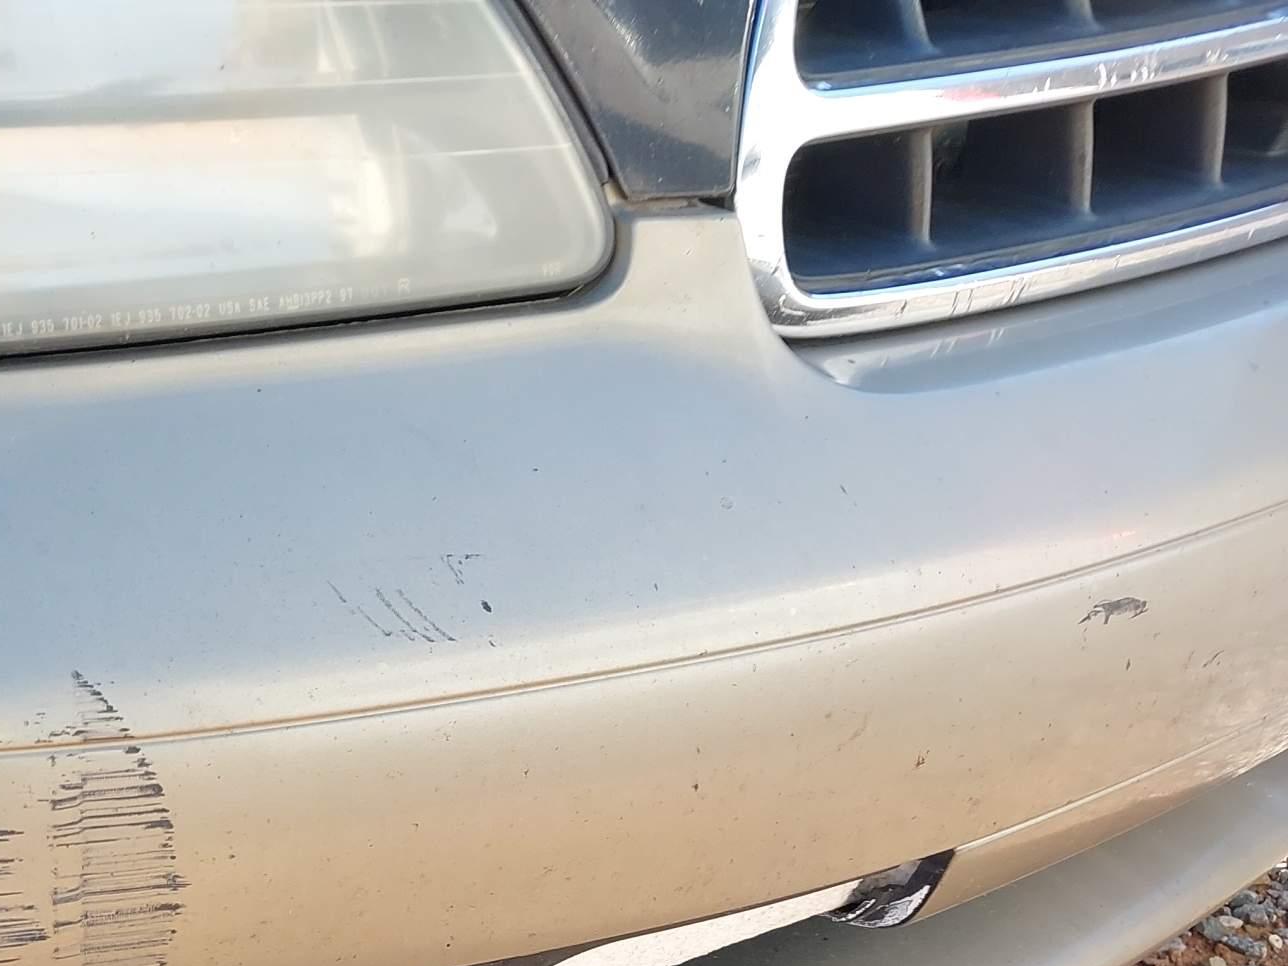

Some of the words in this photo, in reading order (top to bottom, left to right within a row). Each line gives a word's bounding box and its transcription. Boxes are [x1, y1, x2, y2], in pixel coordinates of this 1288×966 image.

[31, 318, 55, 335] 935
[218, 299, 241, 315] USA
[248, 295, 271, 312] SAE
